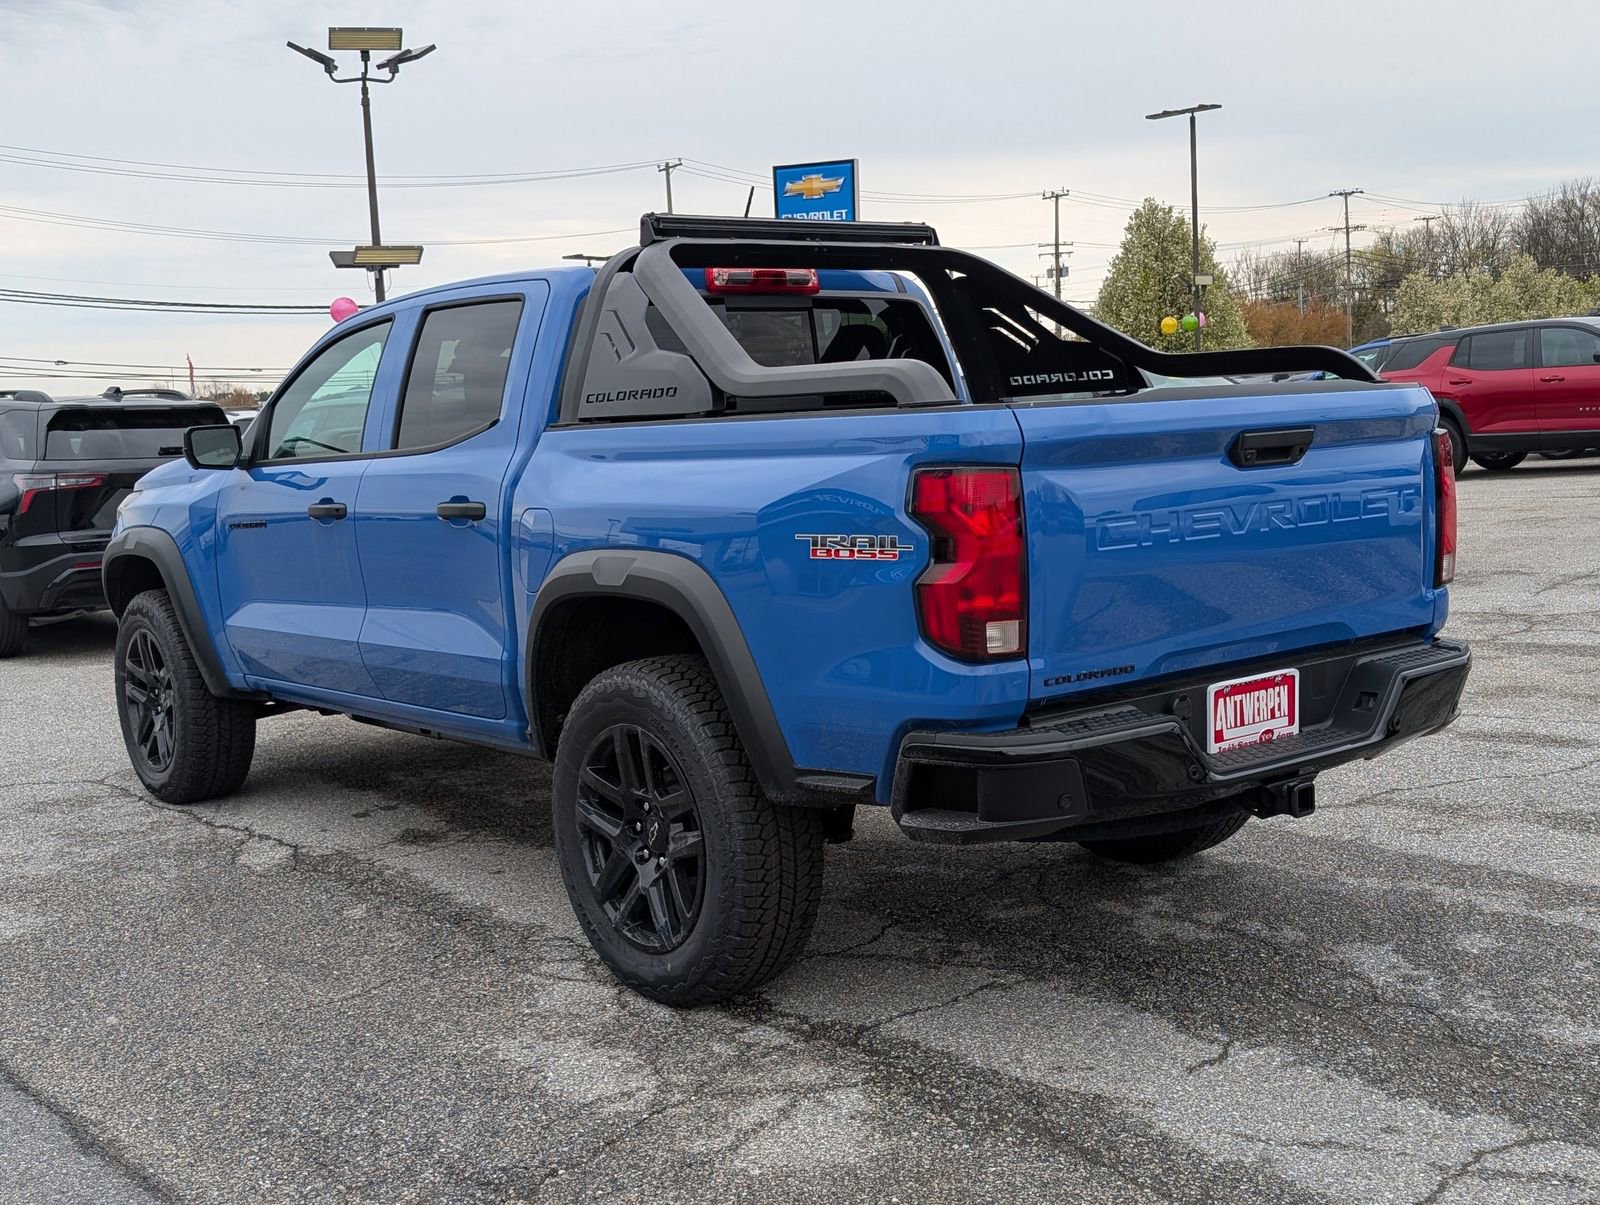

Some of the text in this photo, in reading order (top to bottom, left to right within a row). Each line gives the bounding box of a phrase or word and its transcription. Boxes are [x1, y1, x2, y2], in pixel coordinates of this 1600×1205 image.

[586, 386, 678, 404] COLORADO
[1096, 487, 1419, 551] CHEVROLET
[795, 534, 913, 551] TRAIL
[810, 548, 899, 560] BOSS
[1043, 664, 1136, 687] COLORADO
[1215, 685, 1289, 732] ANTWERPEN
[1260, 732, 1273, 742] Yes
